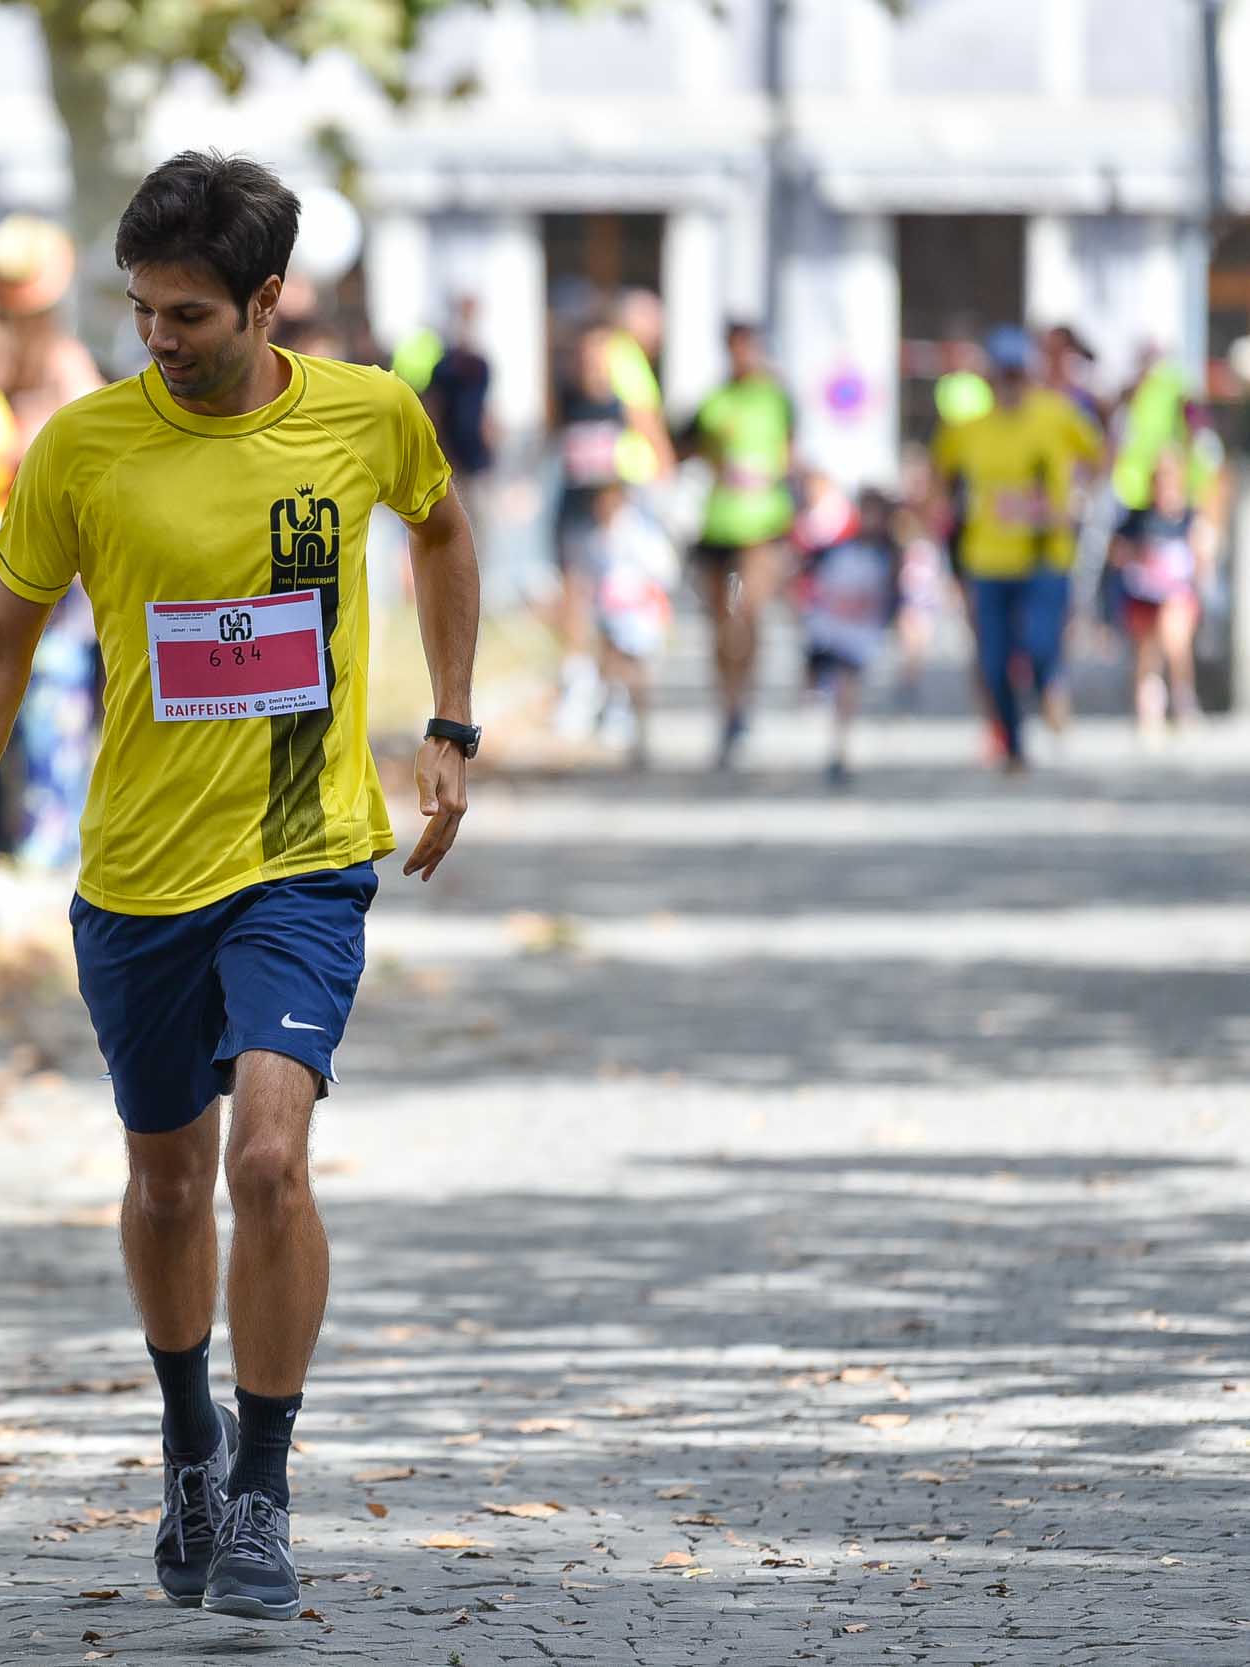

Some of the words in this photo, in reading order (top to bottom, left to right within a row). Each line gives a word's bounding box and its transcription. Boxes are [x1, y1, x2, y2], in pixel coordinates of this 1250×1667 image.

[297, 576, 336, 584] ANNIVERSARY
[268, 696, 283, 704] Emil
[283, 695, 297, 703] Frey
[294, 700, 316, 708] Acacias
[165, 702, 247, 717] RAIFFEISEN
